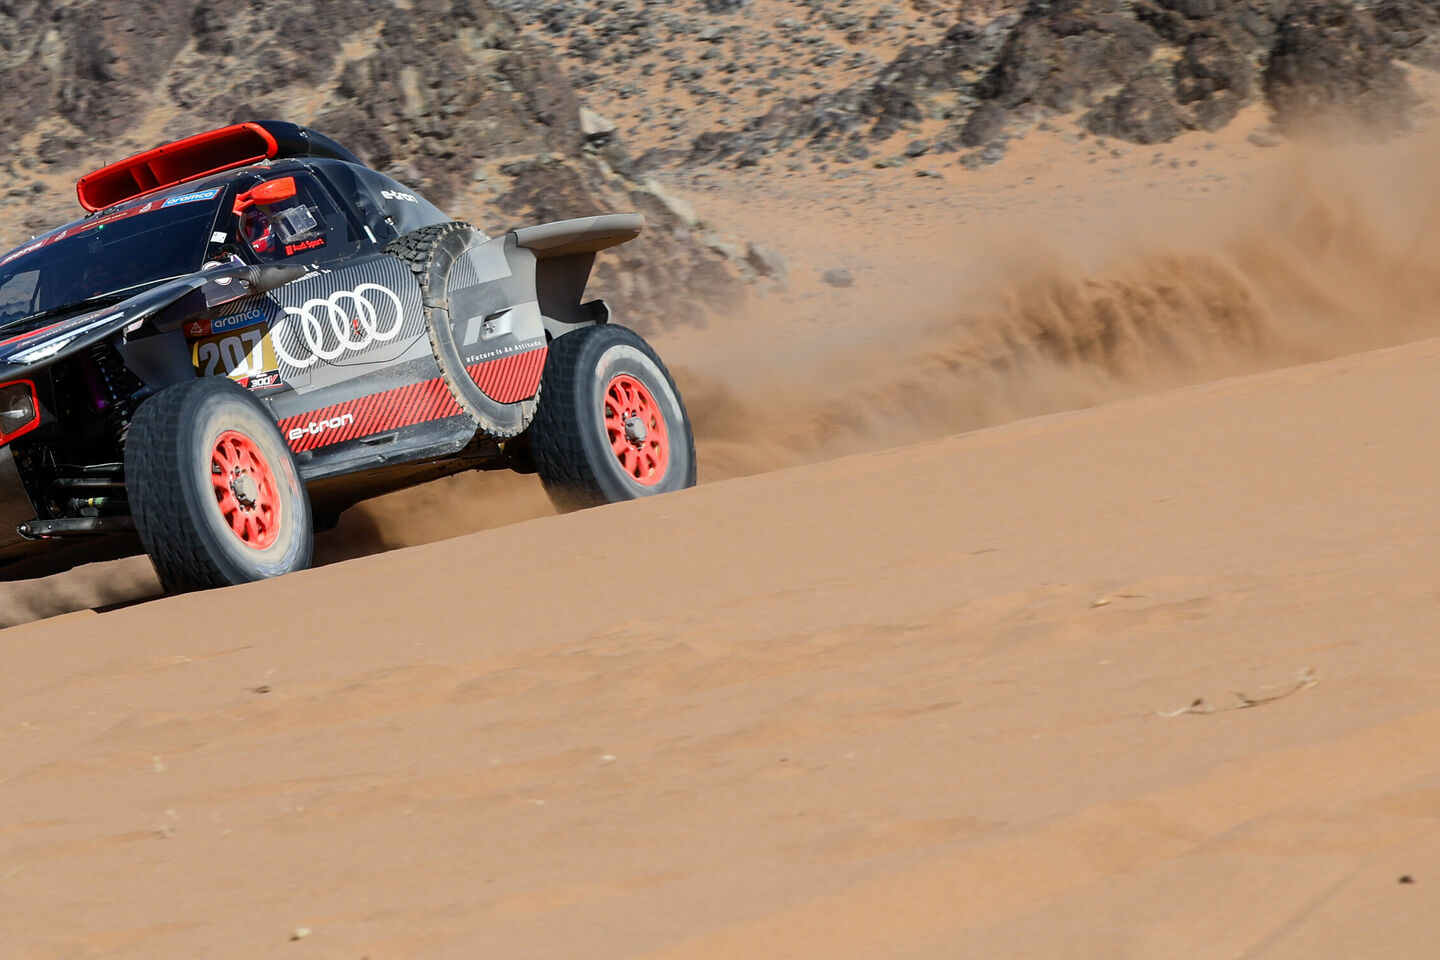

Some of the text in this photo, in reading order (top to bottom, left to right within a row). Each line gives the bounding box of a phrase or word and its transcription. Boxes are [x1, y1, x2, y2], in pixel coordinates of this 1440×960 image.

[167, 192, 213, 204] aramco
[381, 190, 418, 203] e-tron
[293, 238, 325, 252] Audi Sport
[214, 309, 261, 329] aramco
[199, 329, 264, 377] 207
[504, 346, 513, 354] An
[514, 340, 542, 352] Attitude
[250, 373, 279, 388] 300V
[289, 413, 354, 440] e-tron
